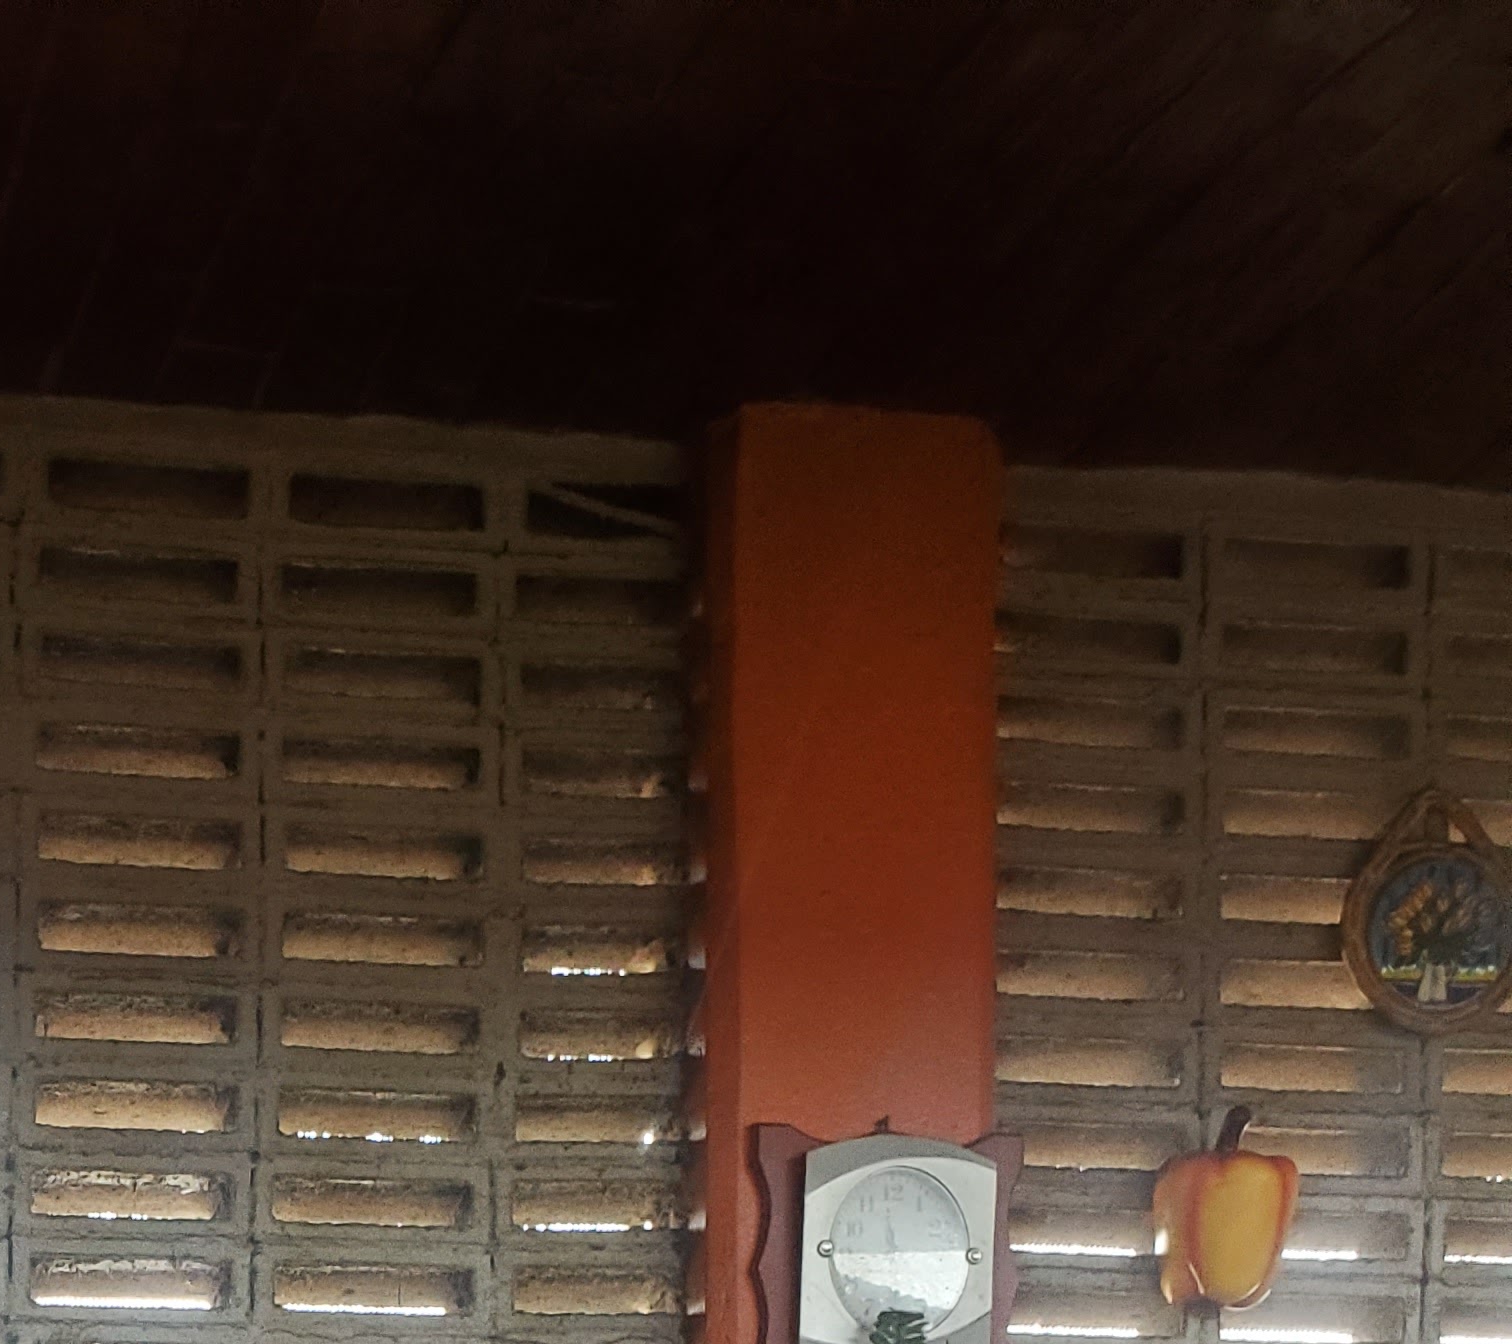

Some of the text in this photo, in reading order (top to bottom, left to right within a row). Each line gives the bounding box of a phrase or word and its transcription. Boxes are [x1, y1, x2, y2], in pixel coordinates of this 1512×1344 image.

[884, 1184, 904, 1202] 12
[860, 1195, 874, 1213] 11
[846, 1220, 864, 1238] 10
